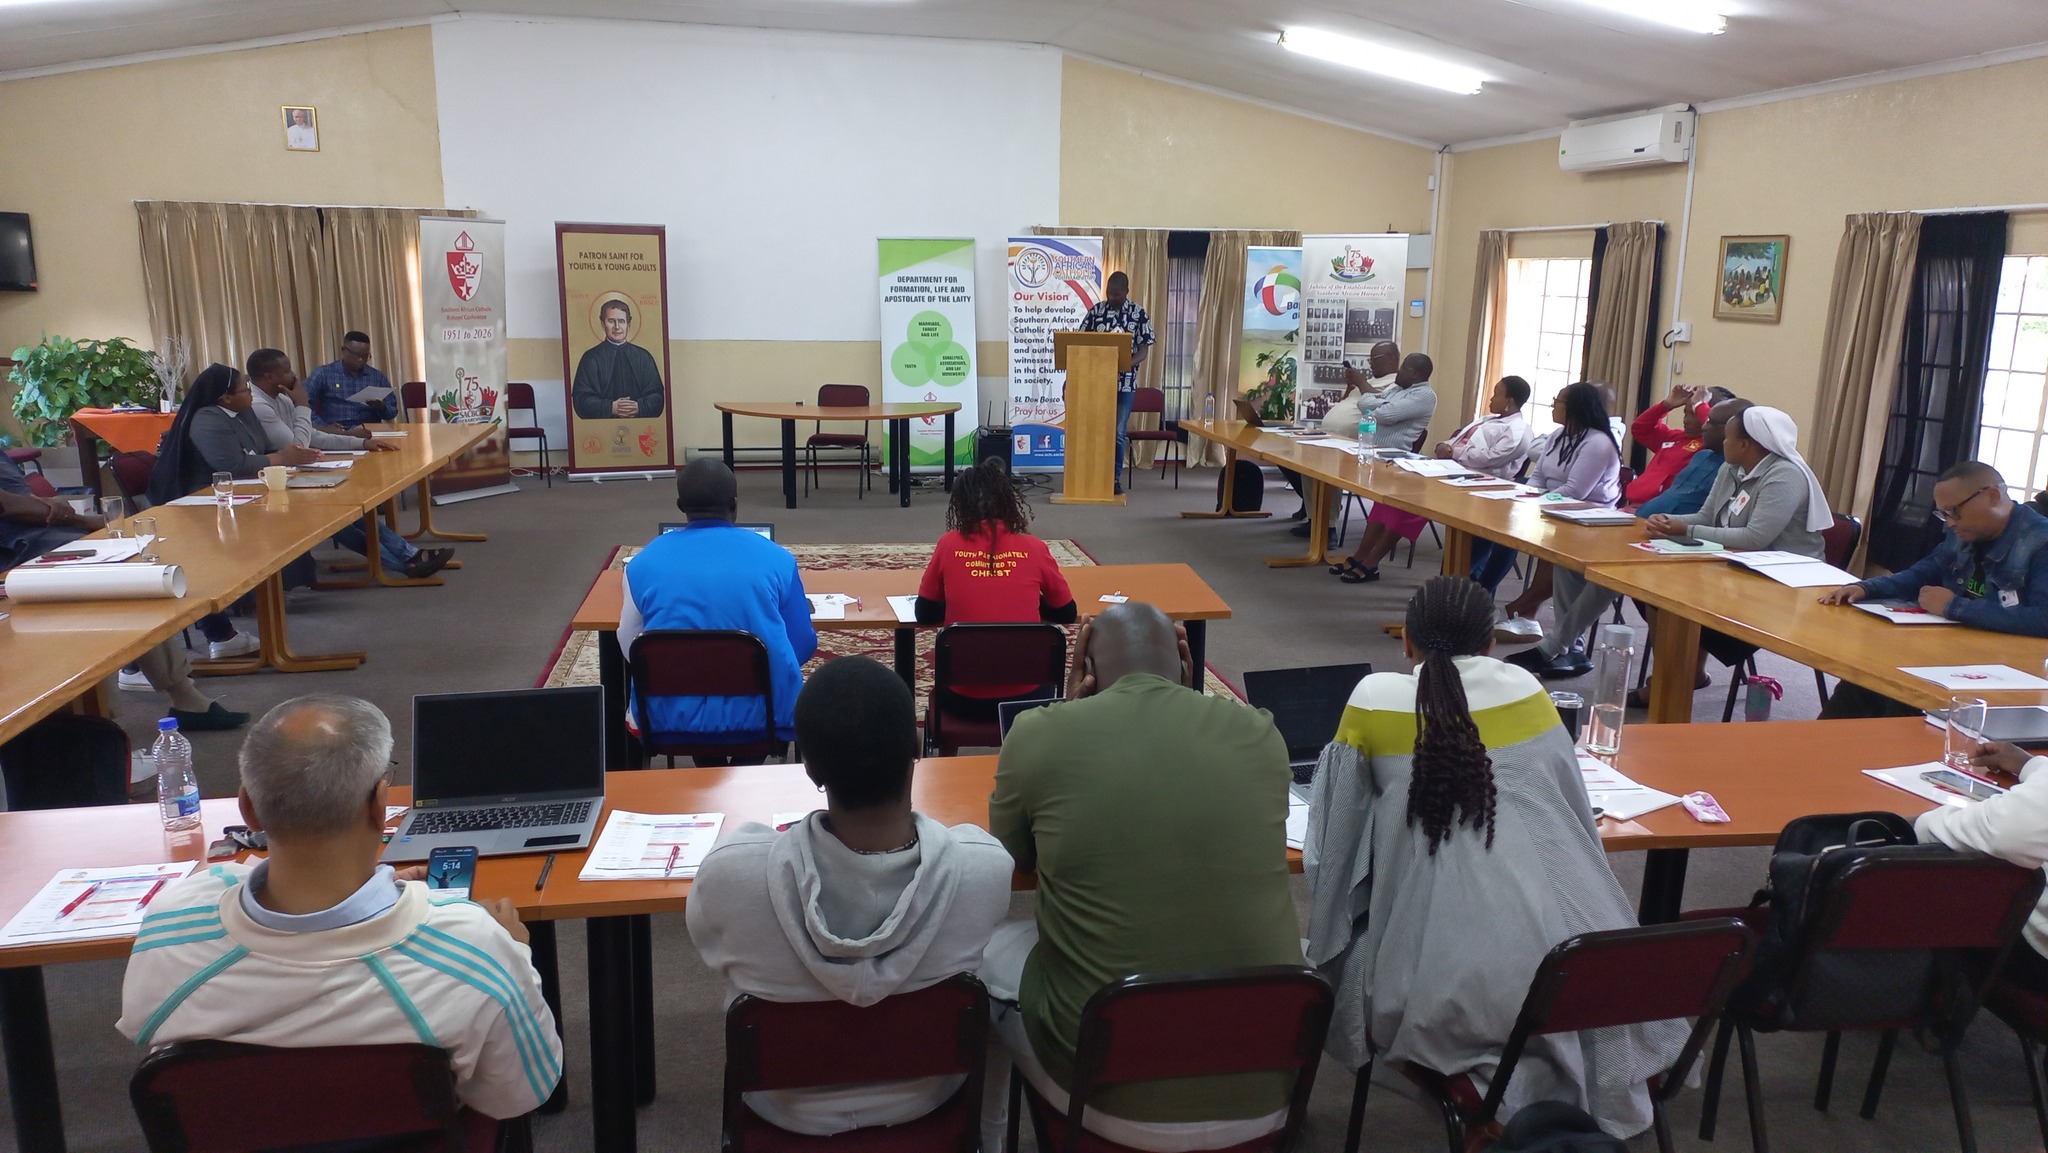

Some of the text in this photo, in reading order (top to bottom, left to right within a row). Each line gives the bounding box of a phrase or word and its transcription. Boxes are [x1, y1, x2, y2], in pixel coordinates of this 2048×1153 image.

[579, 252, 607, 260] PATRON
[608, 252, 629, 260] SAINT
[1350, 250, 1361, 258] 75
[568, 262, 596, 270] YOUTHS
[1054, 262, 1094, 270] AFRICAN
[1014, 292, 1068, 300] Our Vision
[1025, 306, 1042, 314] help
[1044, 306, 1076, 314] develop
[443, 328, 492, 340] 1951 to 2026
[1048, 326, 1070, 334] youth
[464, 376, 479, 391] 75
[1024, 377, 1053, 385] society.
[460, 410, 481, 418] SACBC
[1014, 406, 1032, 417] Pray
[1035, 405, 1046, 416] for
[978, 550, 1028, 560] PASIONATELY
[442, 862, 460, 870] 5:14
